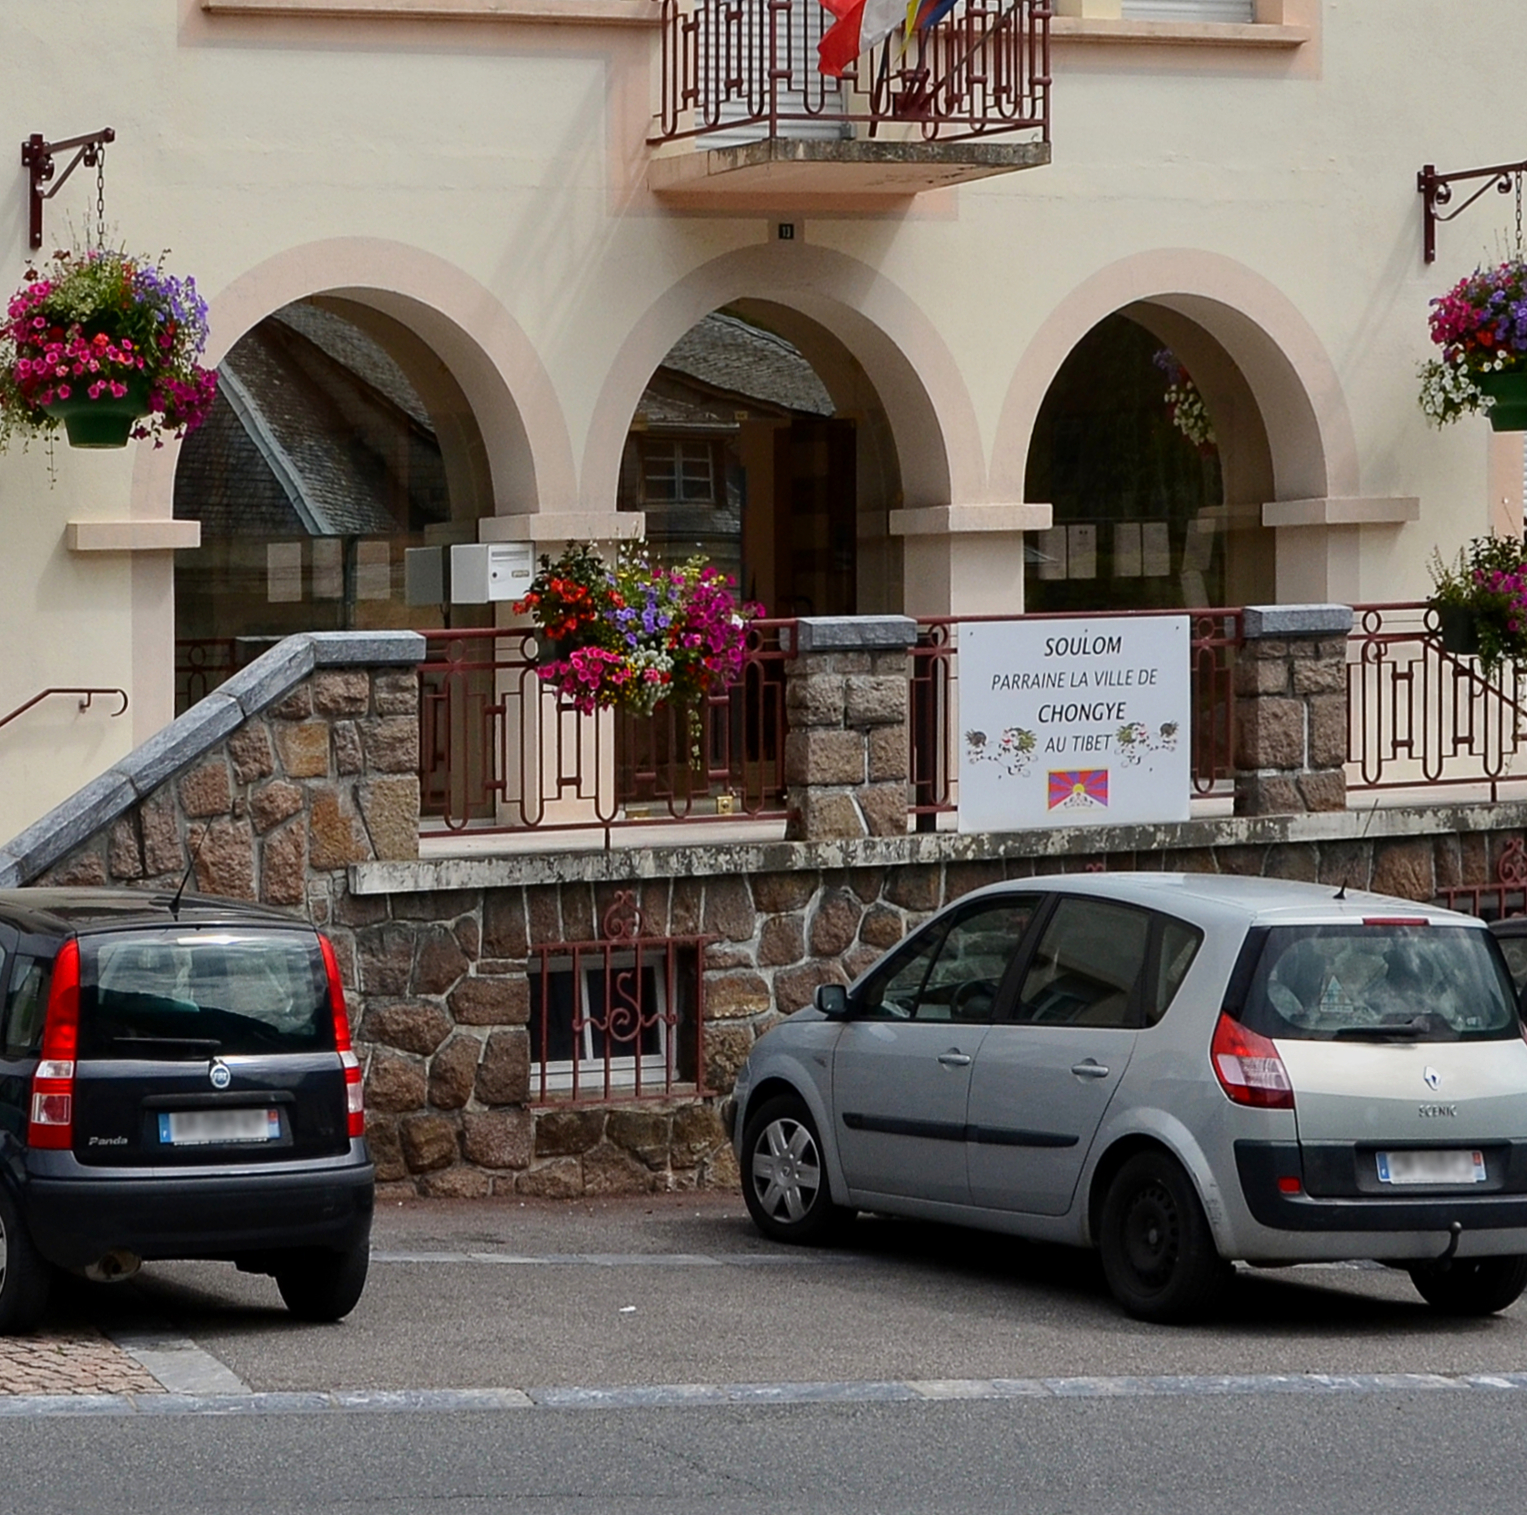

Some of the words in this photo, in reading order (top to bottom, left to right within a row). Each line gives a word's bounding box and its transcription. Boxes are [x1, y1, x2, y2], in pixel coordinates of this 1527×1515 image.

[1044, 636, 1122, 657] SOULOM
[991, 672, 1066, 691] PARRAINE
[1070, 671, 1089, 688] LA
[1094, 669, 1134, 687] VILLE
[1138, 668, 1158, 685] DE
[1038, 702, 1127, 724] CHONGYE
[1044, 736, 1067, 753] AU
[1072, 734, 1113, 752] TIBET
[1418, 1104, 1458, 1118] SCENIC
[88, 1135, 129, 1146] Panda
